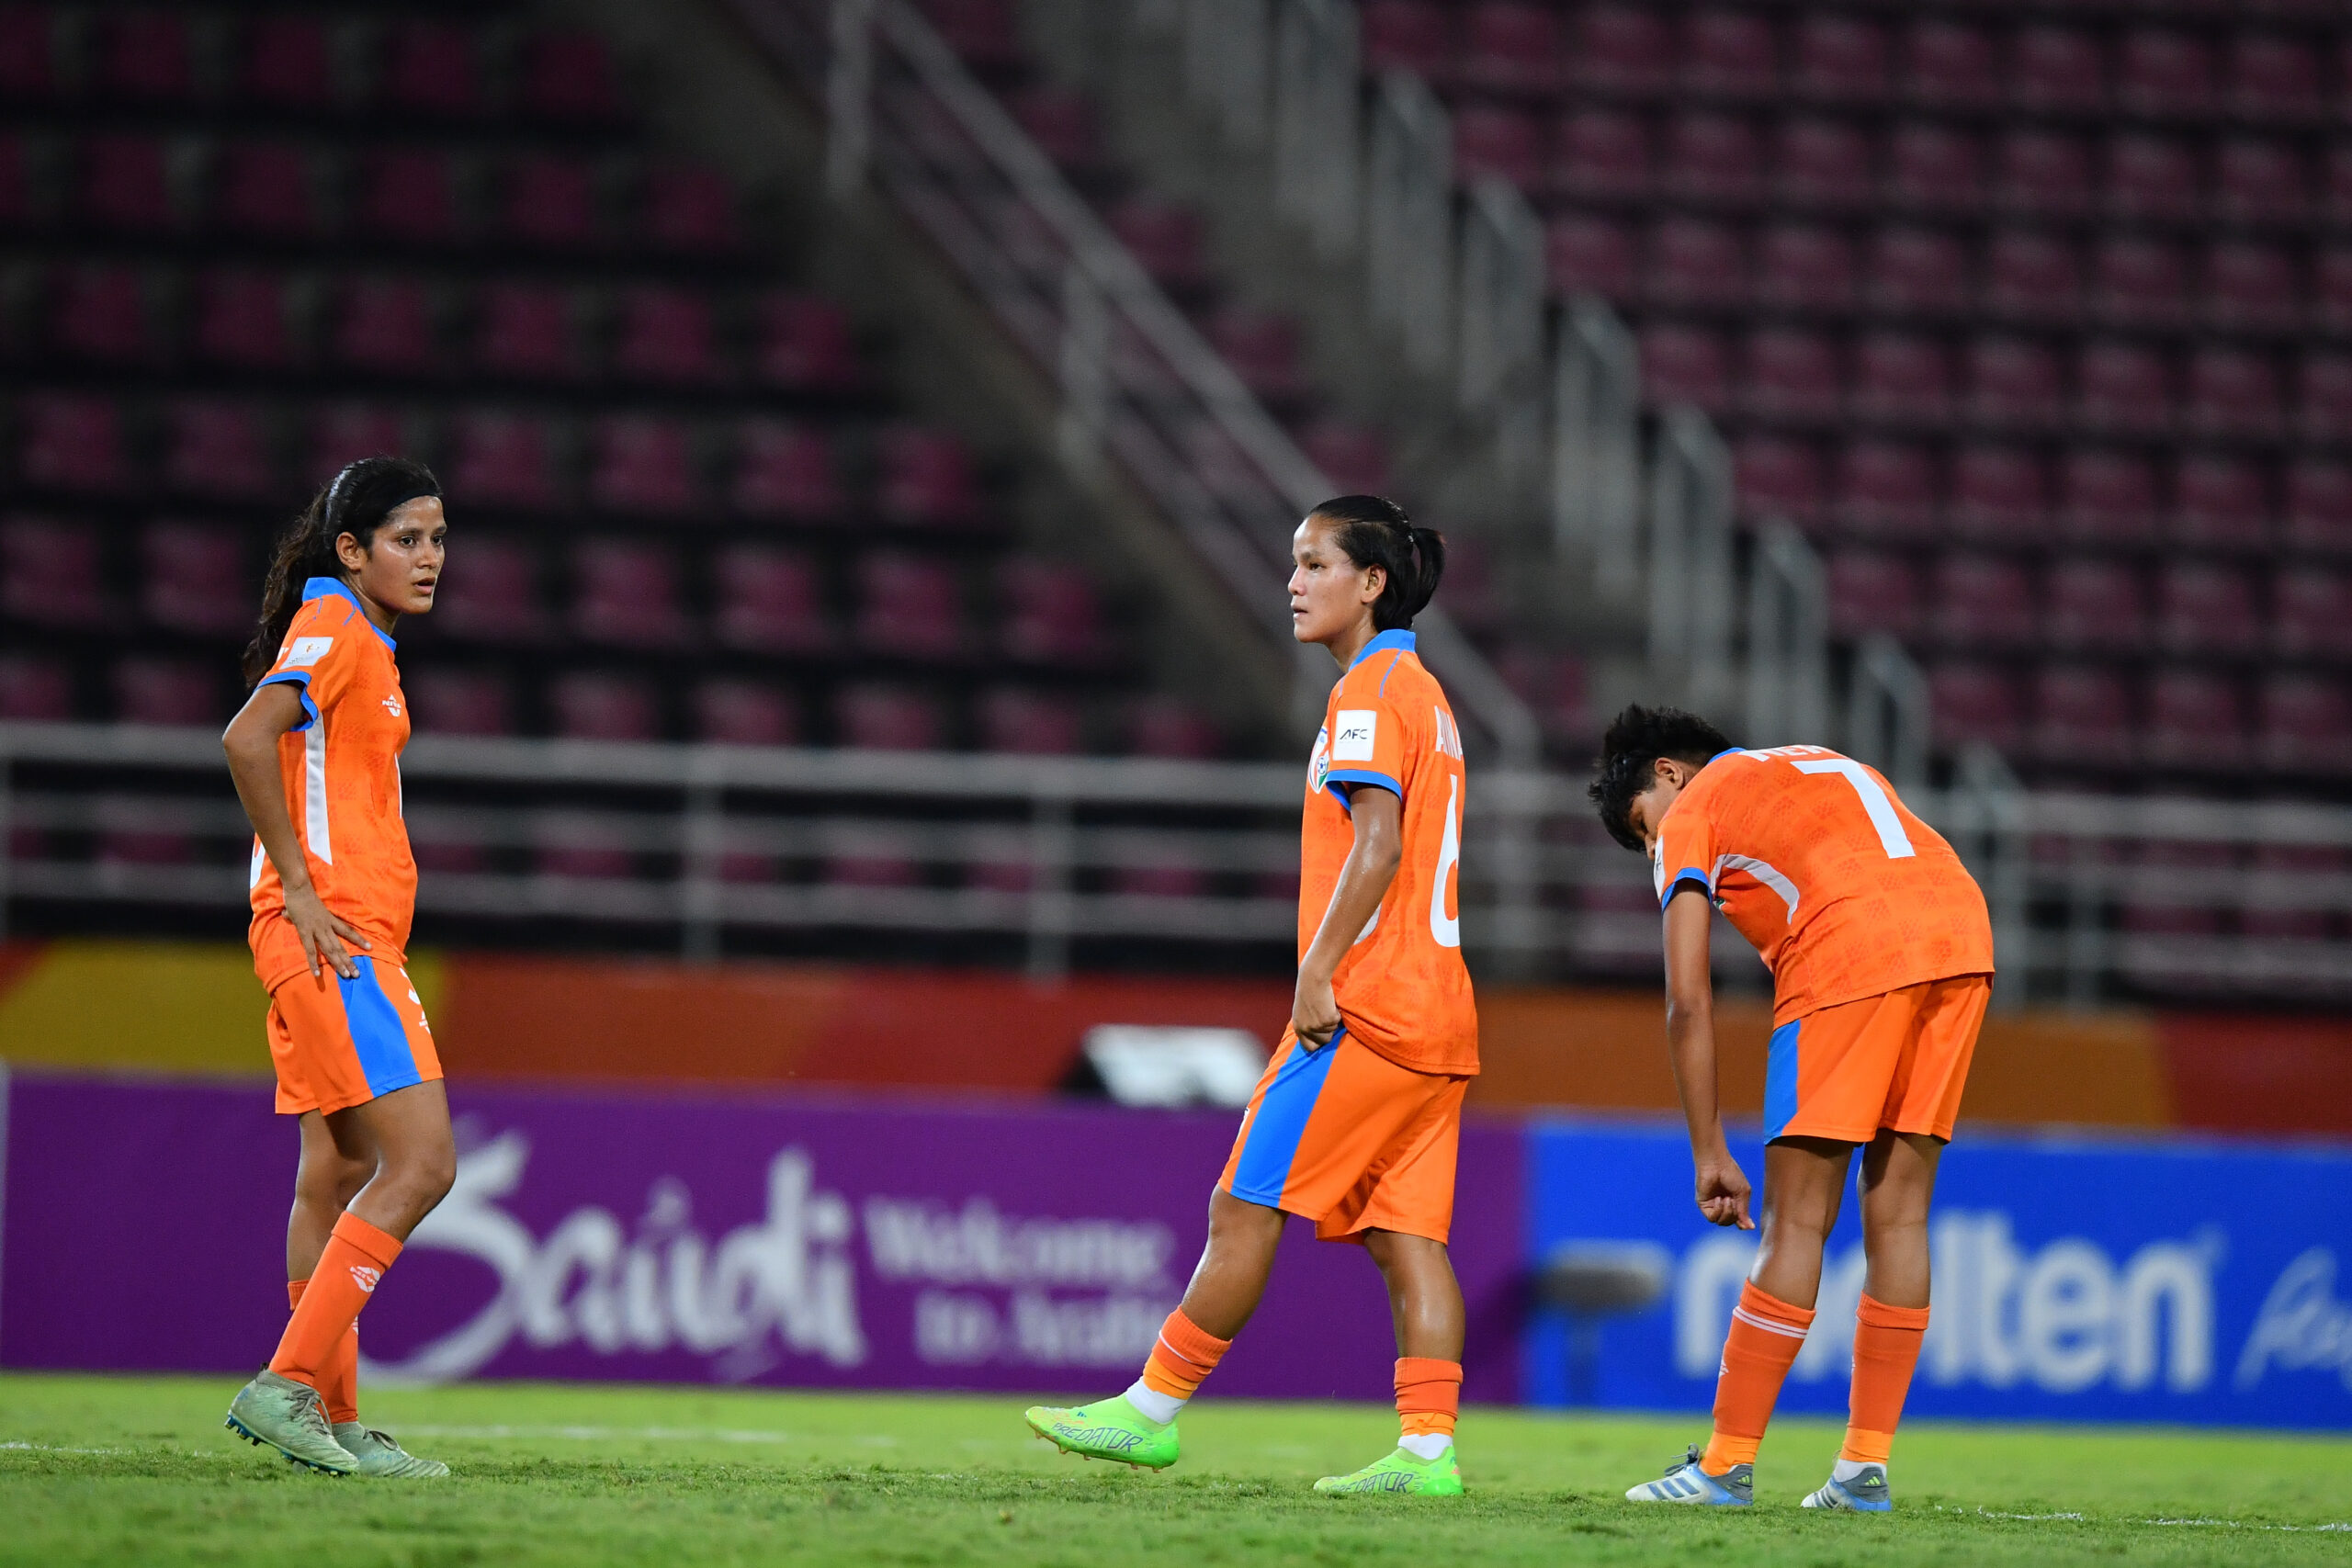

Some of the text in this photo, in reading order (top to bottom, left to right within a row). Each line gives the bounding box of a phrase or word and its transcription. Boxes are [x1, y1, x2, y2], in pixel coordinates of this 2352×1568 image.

[1339, 728, 1368, 740] AFC
[1789, 759, 1917, 859] 7
[1430, 773, 1461, 948] 6
[1051, 1422, 1144, 1452] PREDATOR
